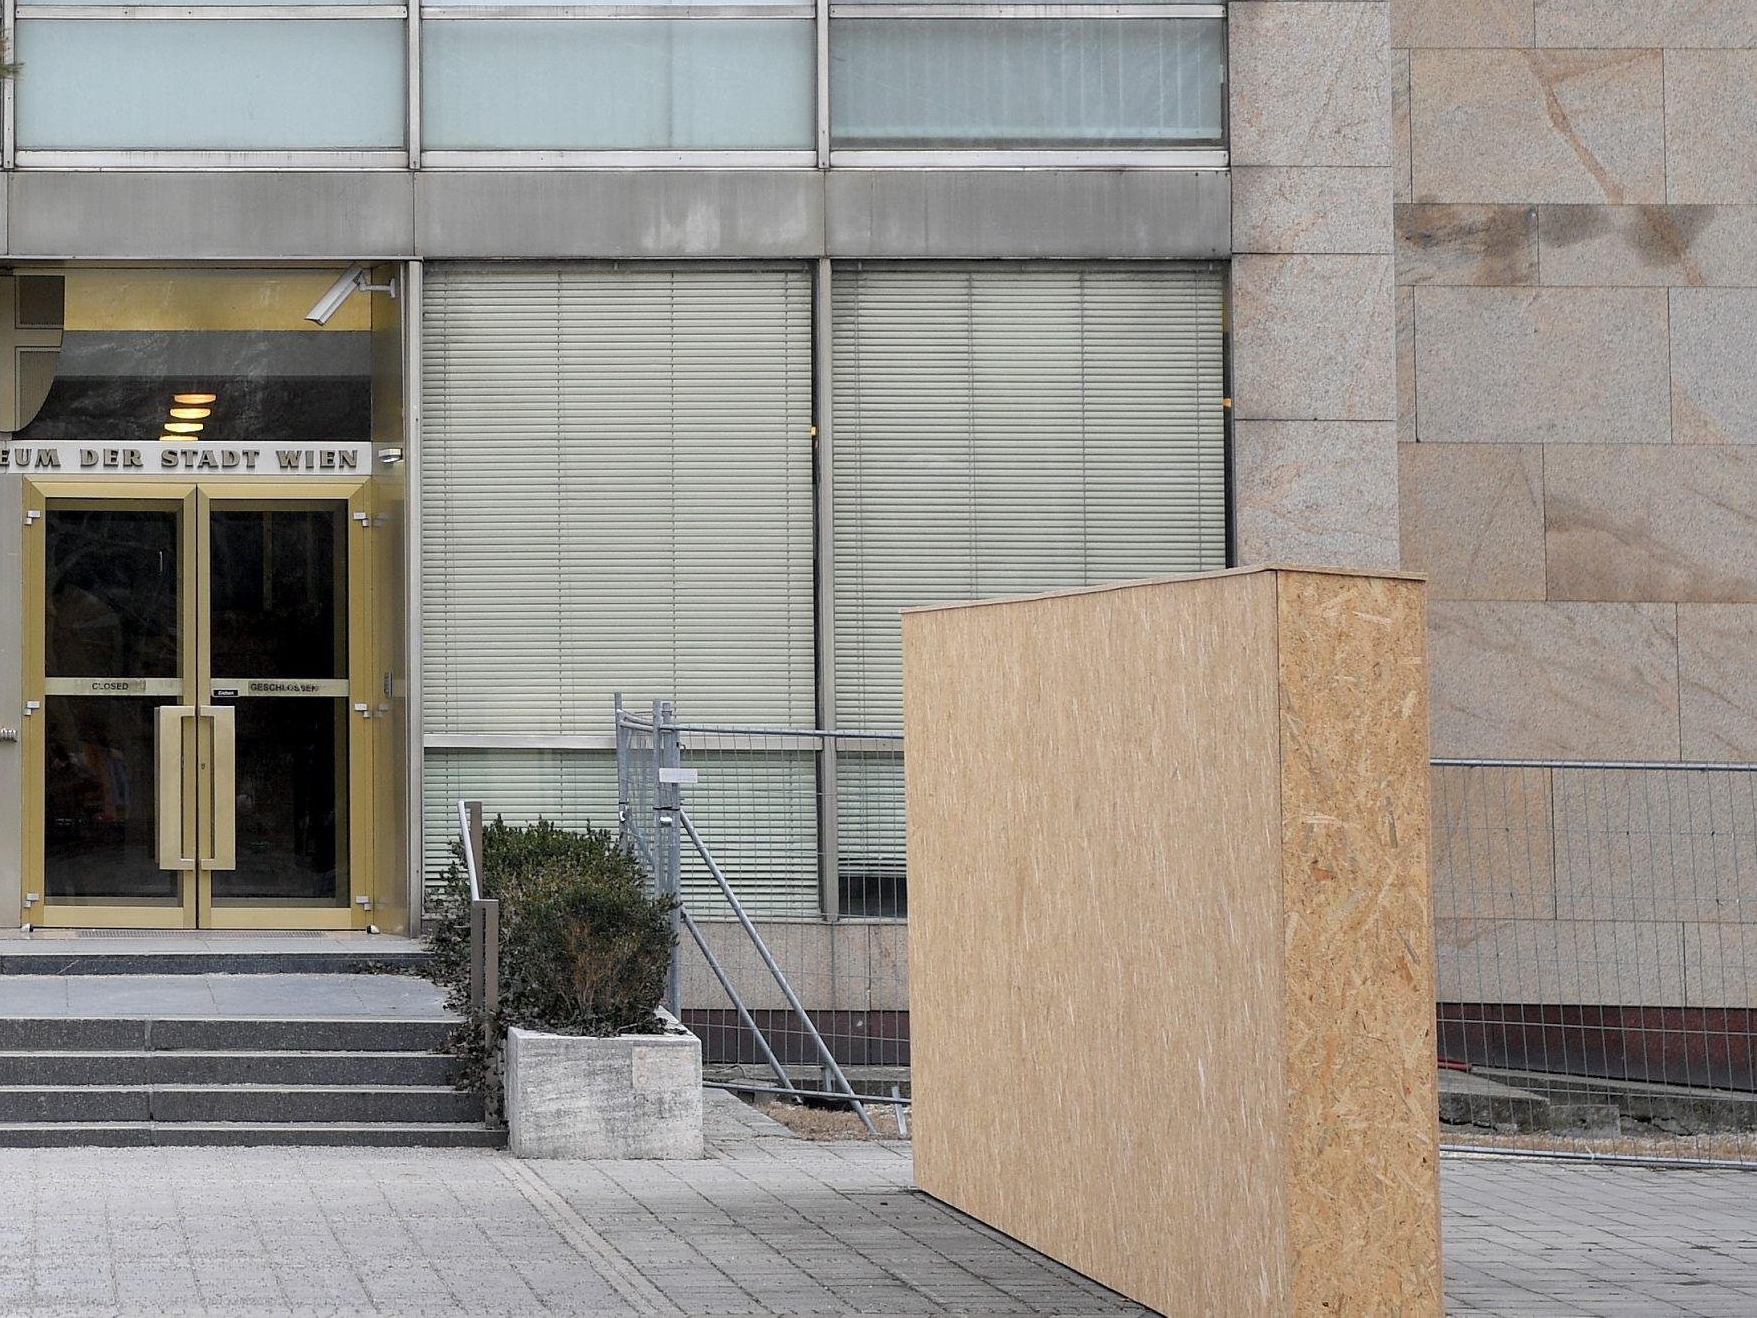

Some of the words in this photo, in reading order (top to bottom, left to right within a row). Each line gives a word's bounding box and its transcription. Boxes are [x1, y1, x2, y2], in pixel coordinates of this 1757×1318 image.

[80, 448, 143, 467] DER
[161, 449, 260, 468] STADT
[276, 449, 359, 468] WIEN
[91, 682, 129, 691] CLOSED
